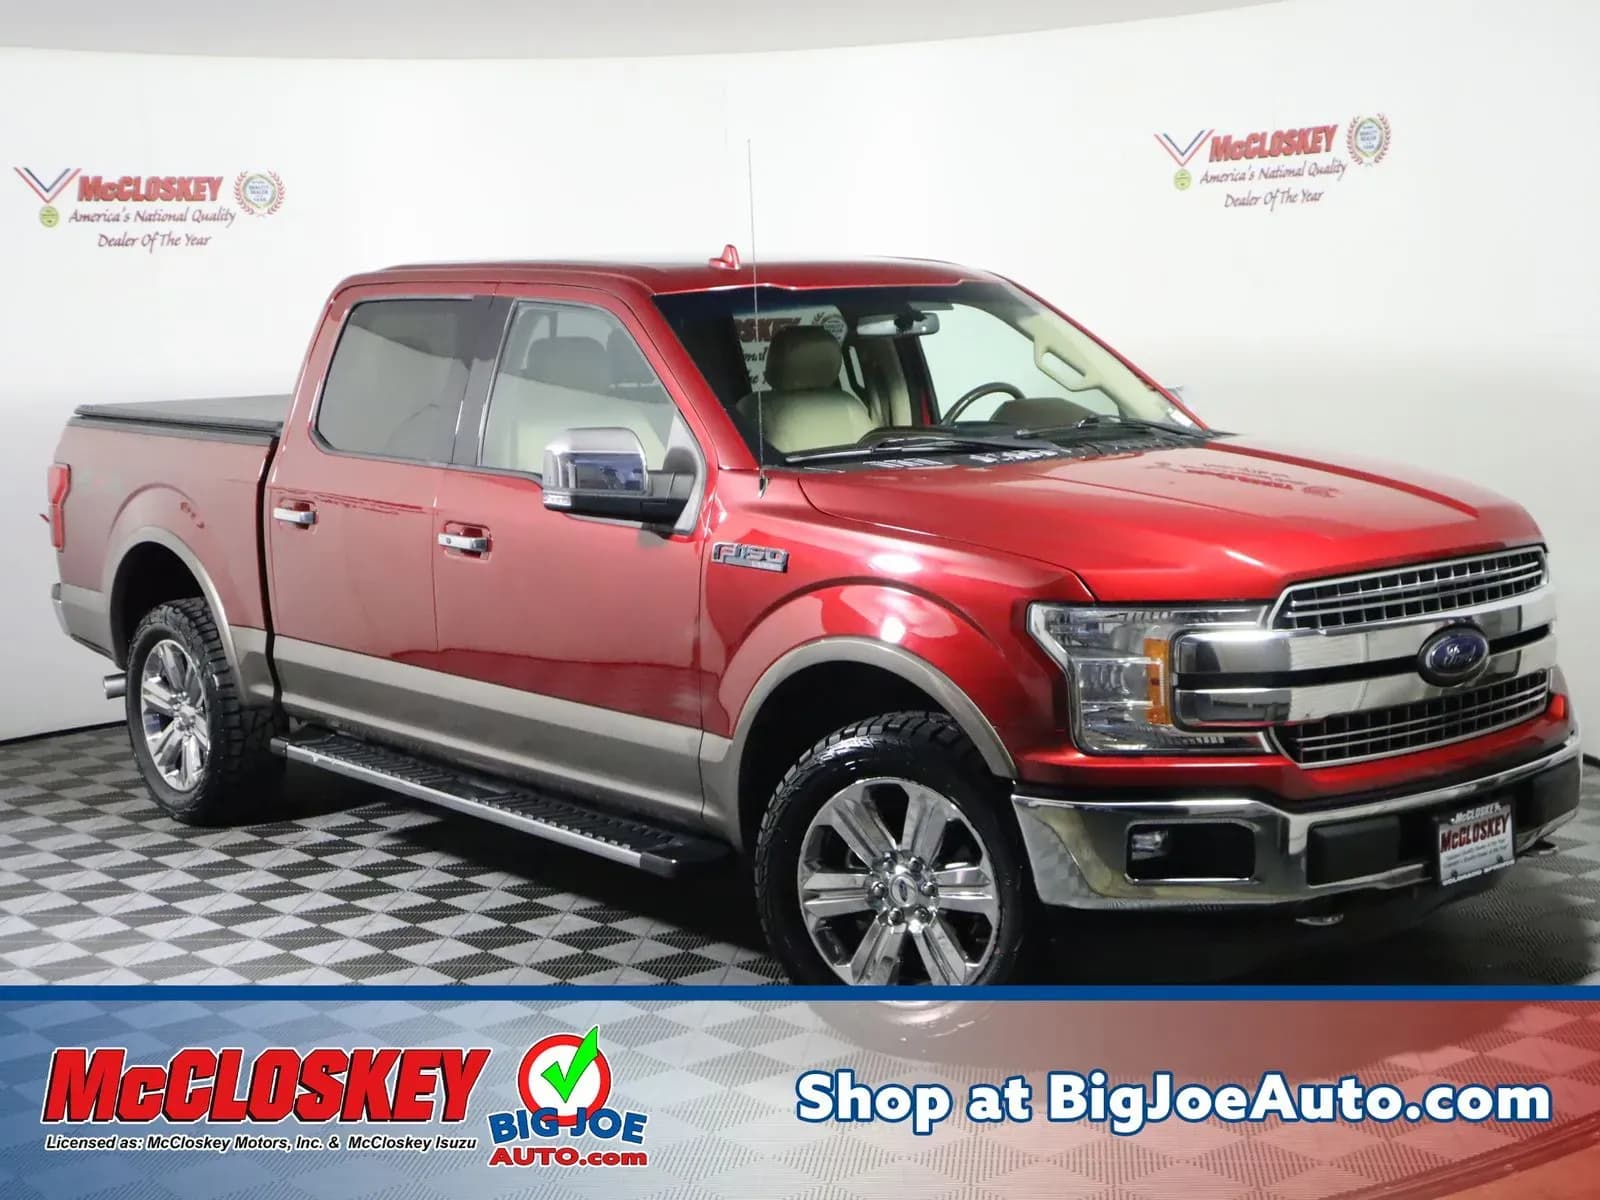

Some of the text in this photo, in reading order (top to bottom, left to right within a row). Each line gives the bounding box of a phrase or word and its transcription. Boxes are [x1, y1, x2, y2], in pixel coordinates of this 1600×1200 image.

[1209, 124, 1339, 163] McCLOSKEY
[1199, 164, 1254, 184] America's
[1257, 161, 1305, 181] National
[1307, 157, 1348, 182] Quality
[78, 175, 223, 201] McCLOSKEY
[1224, 188, 1325, 212] Dealer Of The Year
[68, 207, 130, 223] America's
[133, 207, 188, 223] National
[191, 207, 236, 228] Quality
[97, 232, 212, 253] Dealer Of The Year
[1440, 812, 1510, 853] McCLOSKEY
